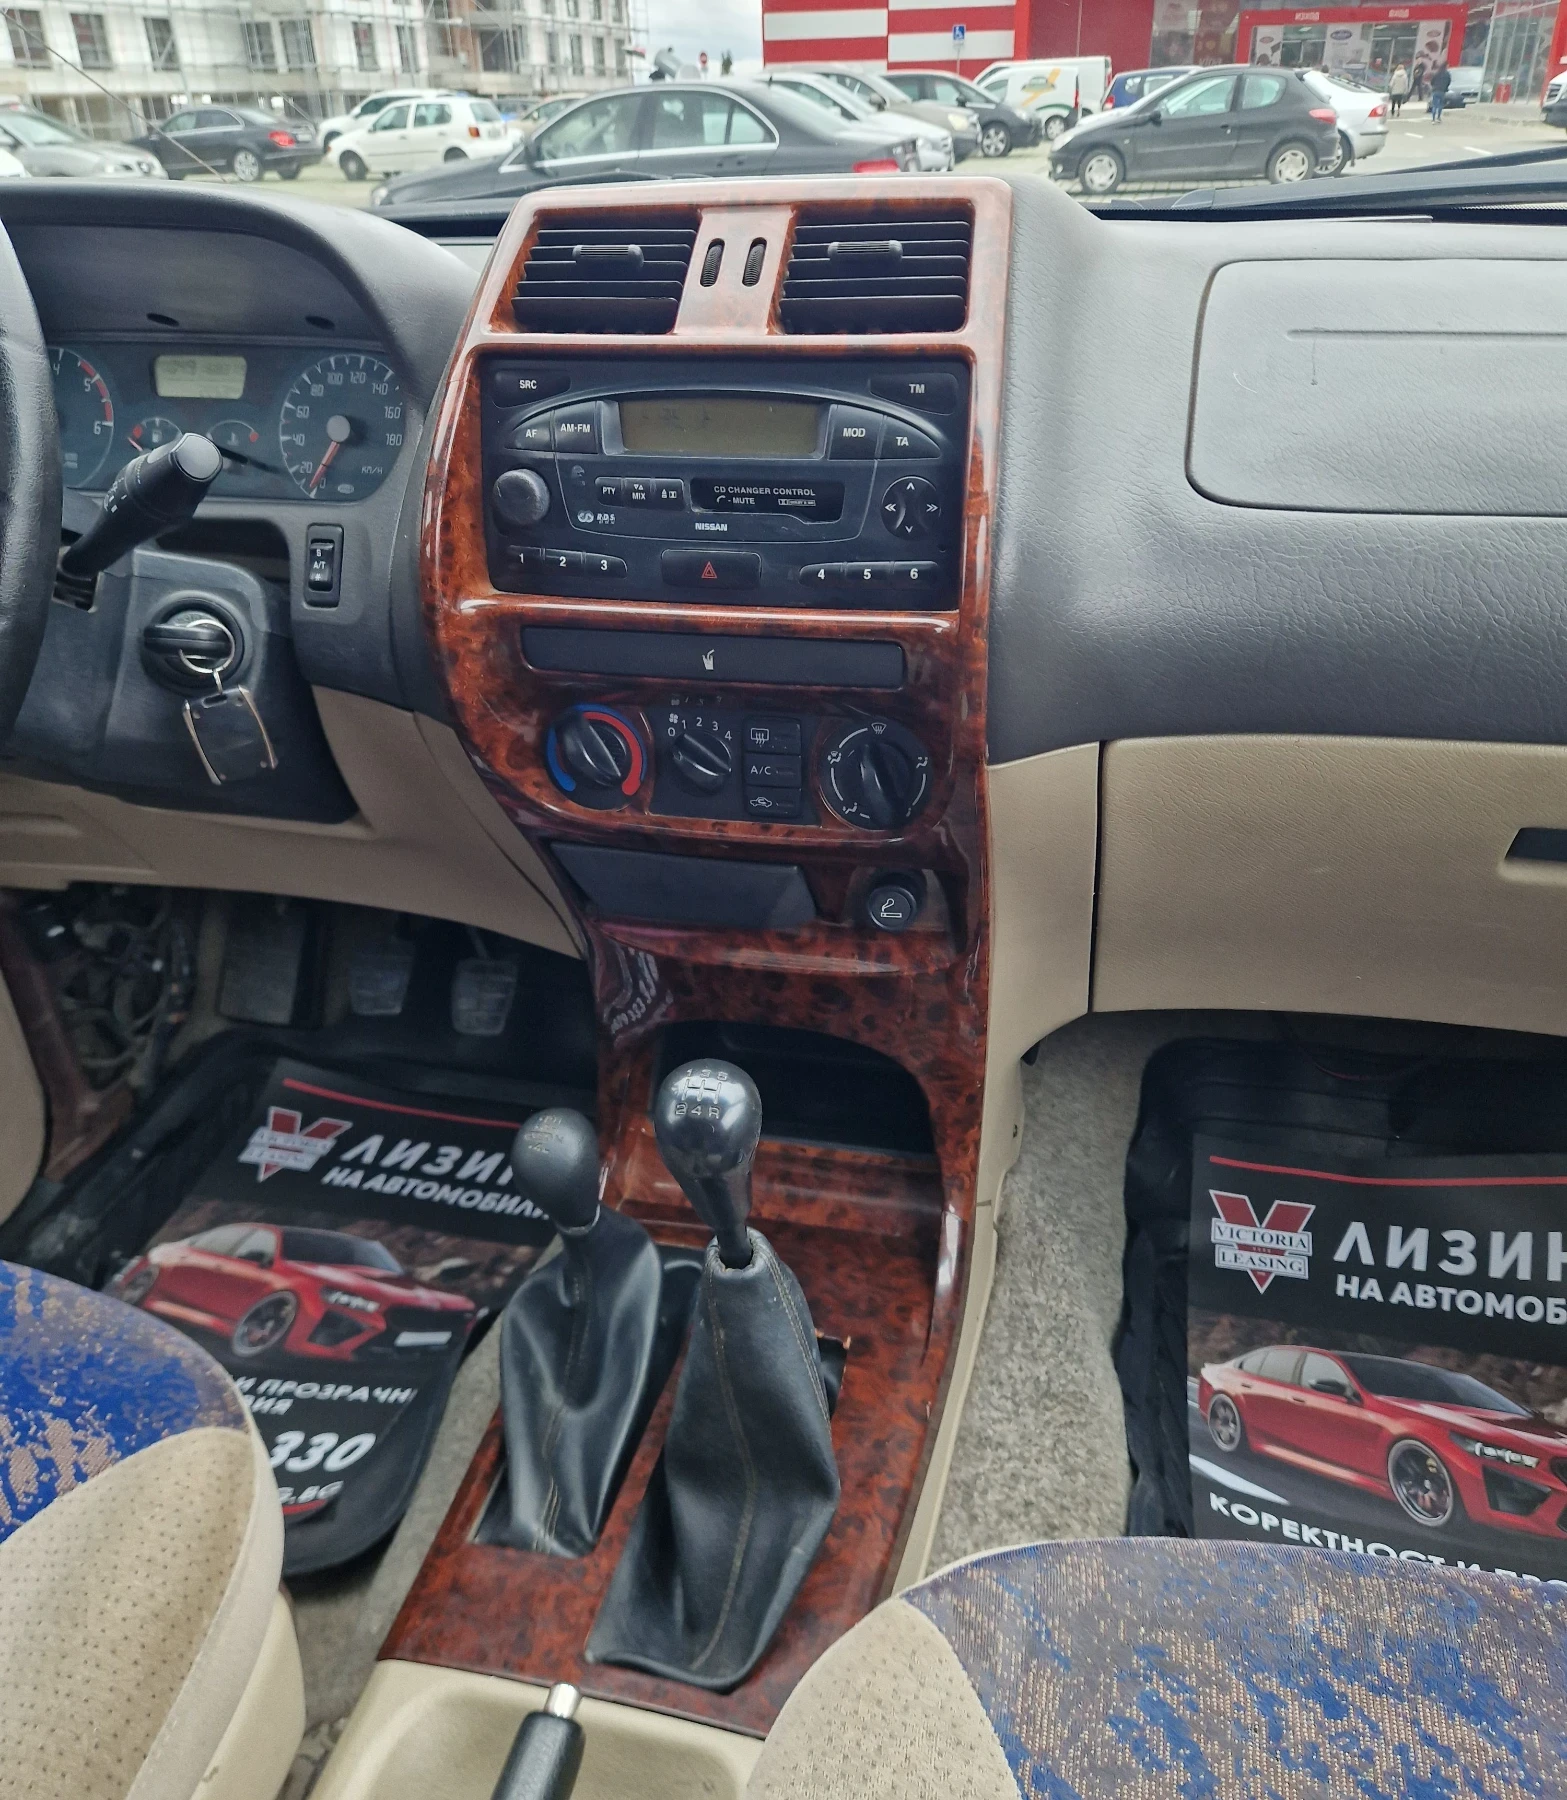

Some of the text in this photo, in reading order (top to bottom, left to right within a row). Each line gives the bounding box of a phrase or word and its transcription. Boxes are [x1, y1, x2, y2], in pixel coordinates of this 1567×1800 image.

[53, 364, 60, 375] 4
[327, 373, 343, 385] 100
[351, 372, 366, 384] 120
[84, 379, 91, 392] 5
[310, 384, 324, 396] 80
[372, 383, 388, 395] 140
[519, 379, 537, 390] SRC
[909, 383, 925, 394] TM
[296, 406, 309, 418] 60
[385, 406, 400, 419] 160
[93, 422, 101, 435] 6
[525, 428, 537, 438] AF
[843, 427, 866, 438] MOD
[293, 437, 305, 447] 40
[386, 433, 402, 446] 180
[896, 436, 909, 446] TA
[300, 462, 313, 474] 20
[602, 486, 616, 495] PTY
[632, 491, 646, 500] MIX
[713, 485, 816, 496] CD CHANGER CONTROL
[694, 522, 728, 532] NISSAN
[313, 561, 326, 570] A/T
[519, 552, 608, 570] 1 2 3
[817, 568, 918, 580] 4 5 6
[667, 717, 732, 741] 0 1 2 3 4
[750, 765, 772, 776] A/C
[686, 1068, 693, 1077] 1
[701, 1069, 712, 1078] 3
[675, 1103, 720, 1120] 2 4 R
[321, 1166, 365, 1189] НА
[1215, 1224, 1308, 1250] VICTORIA
[1220, 1251, 1303, 1273] LEASING
[1336, 1274, 1384, 1303] НА
